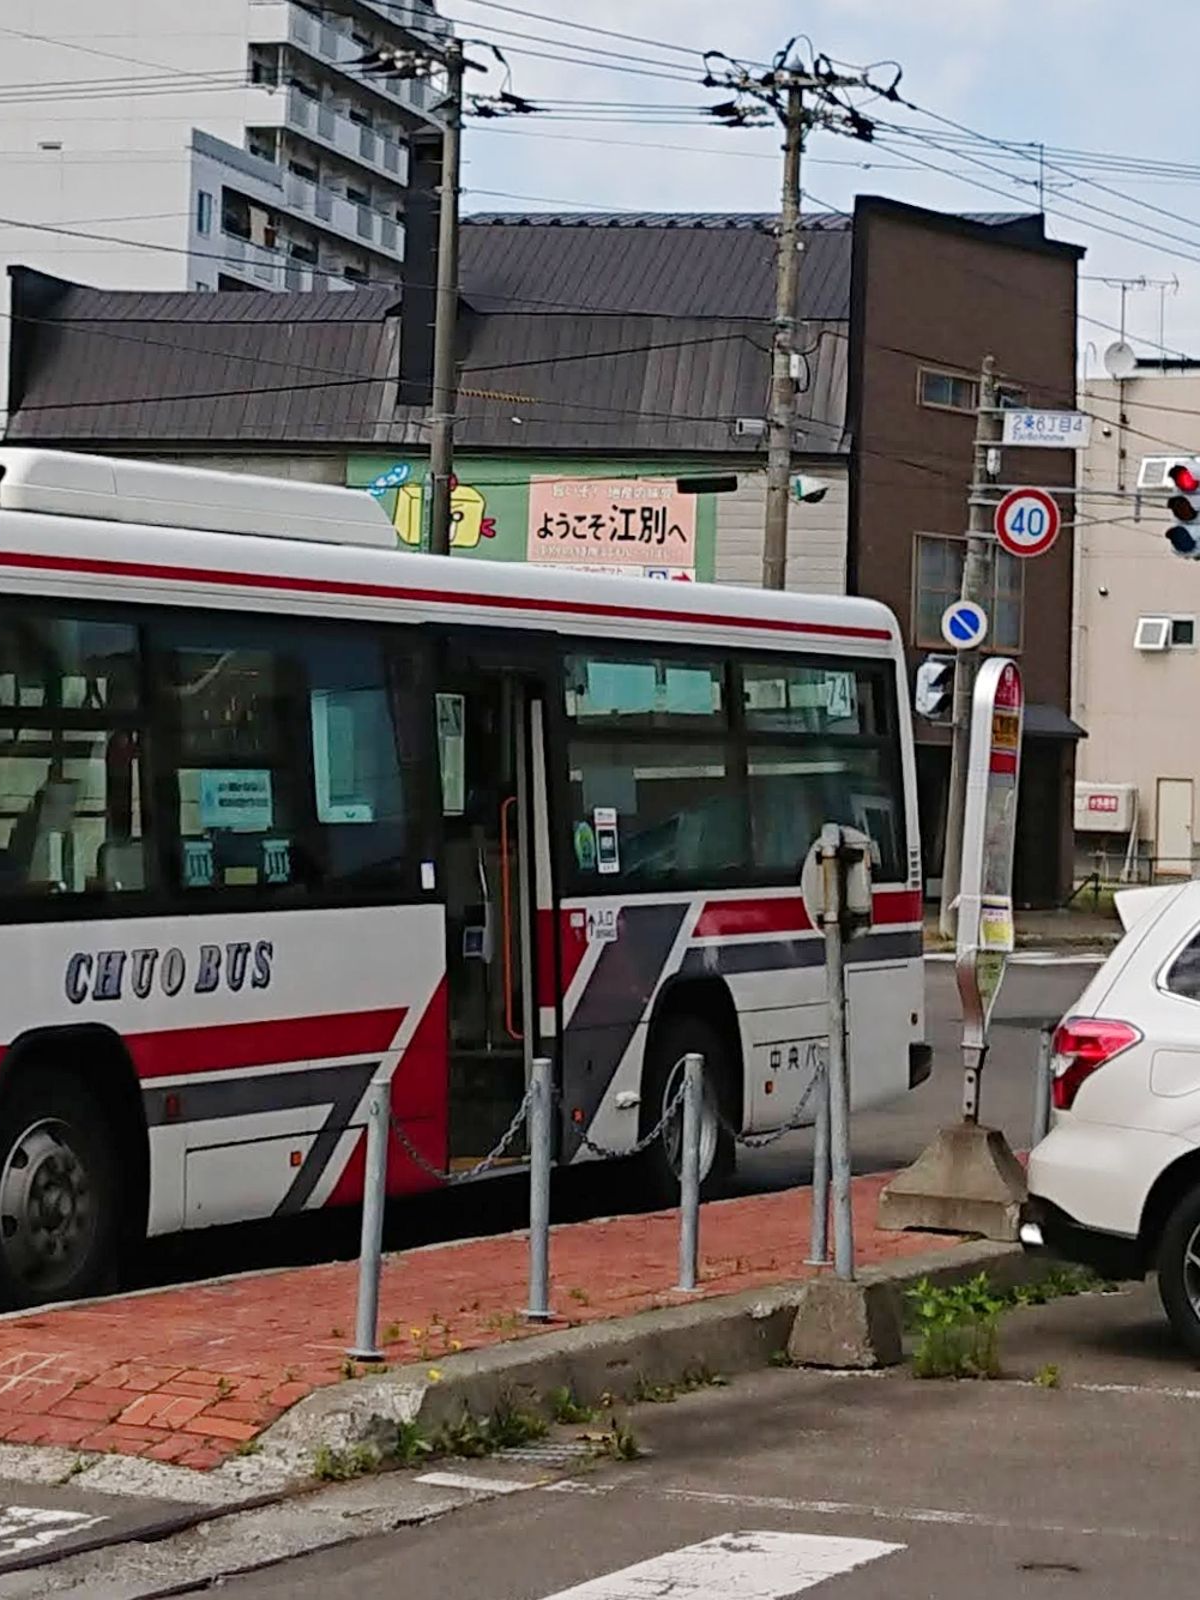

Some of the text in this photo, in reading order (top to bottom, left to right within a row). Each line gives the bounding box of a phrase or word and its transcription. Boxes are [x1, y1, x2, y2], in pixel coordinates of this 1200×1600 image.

[537, 504, 687, 545] ようこそ江別へ
[1011, 507, 1044, 536] 40
[65, 940, 274, 1005] CHUO BUS
[769, 1044, 817, 1073] 中央バ
